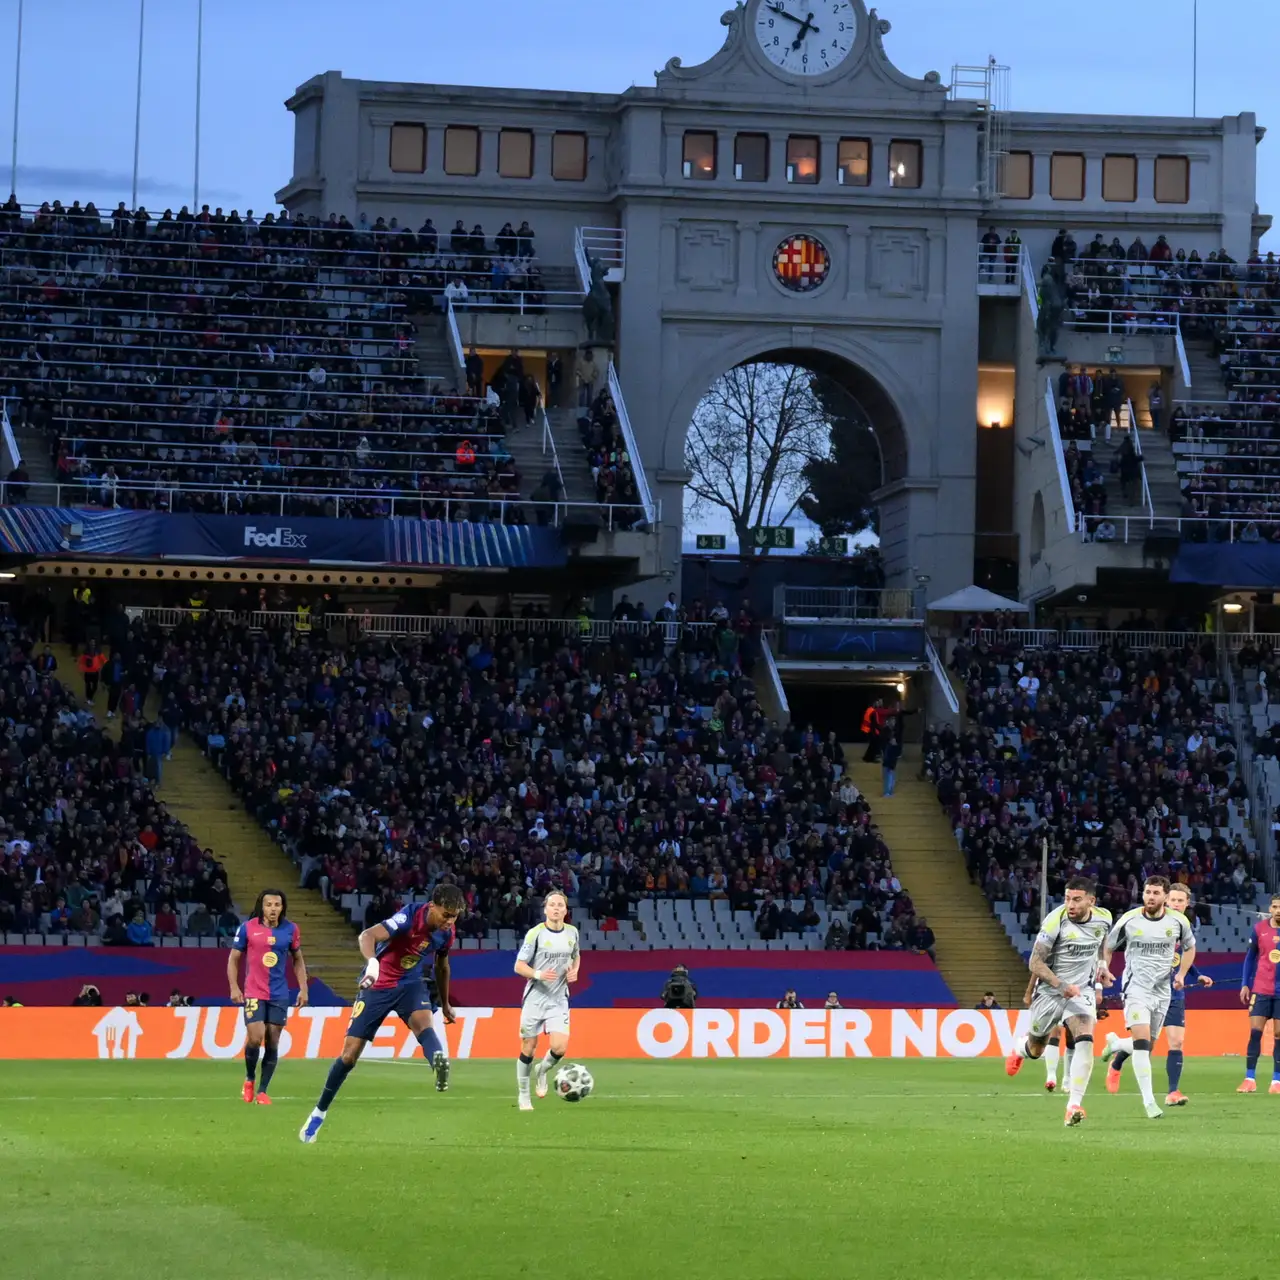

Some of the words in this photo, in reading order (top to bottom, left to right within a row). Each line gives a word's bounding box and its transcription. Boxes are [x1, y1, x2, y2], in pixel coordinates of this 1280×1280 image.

[775, 1, 784, 11] 10
[833, 4, 839, 14] 2
[768, 19, 774, 28] 9
[838, 22, 844, 31] 3
[773, 36, 779, 46] 8
[832, 39, 838, 48] 4
[784, 47, 790, 57] 7
[820, 49, 826, 59] 5
[802, 54, 808, 64] 6
[244, 526, 308, 548] FedEx
[636, 1008, 873, 1058] ORDER
